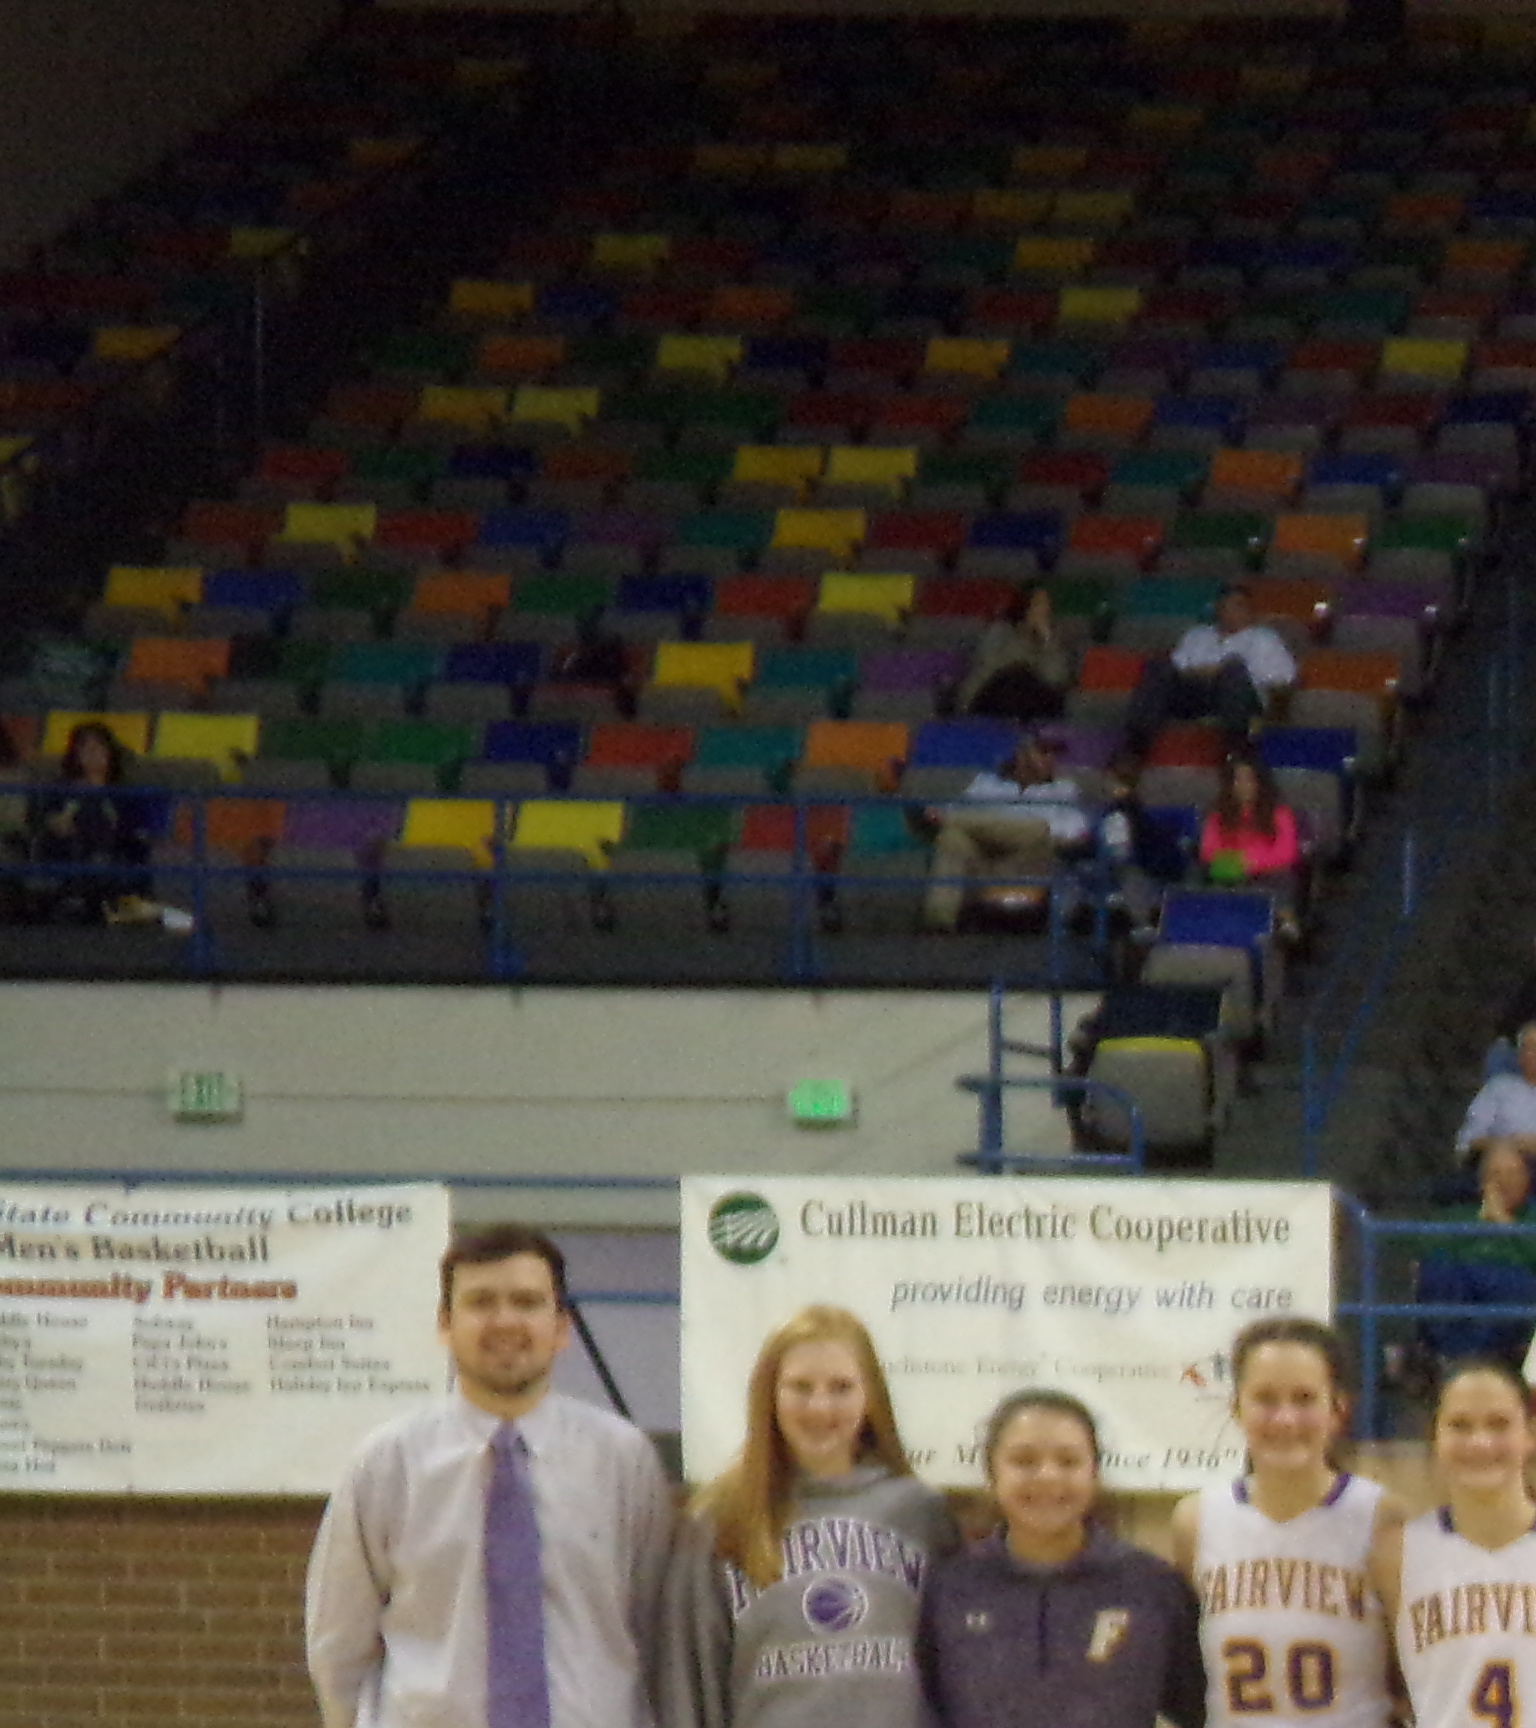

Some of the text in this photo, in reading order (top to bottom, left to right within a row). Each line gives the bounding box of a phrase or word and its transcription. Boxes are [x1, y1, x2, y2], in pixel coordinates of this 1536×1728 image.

[285, 1198, 413, 1230] College
[799, 1199, 1291, 1252] Cullman Electric Cooperative
[888, 1274, 1294, 1315] providing energy with care
[726, 1517, 926, 1620] FIRVIEW
[1222, 1636, 1341, 1716] 20
